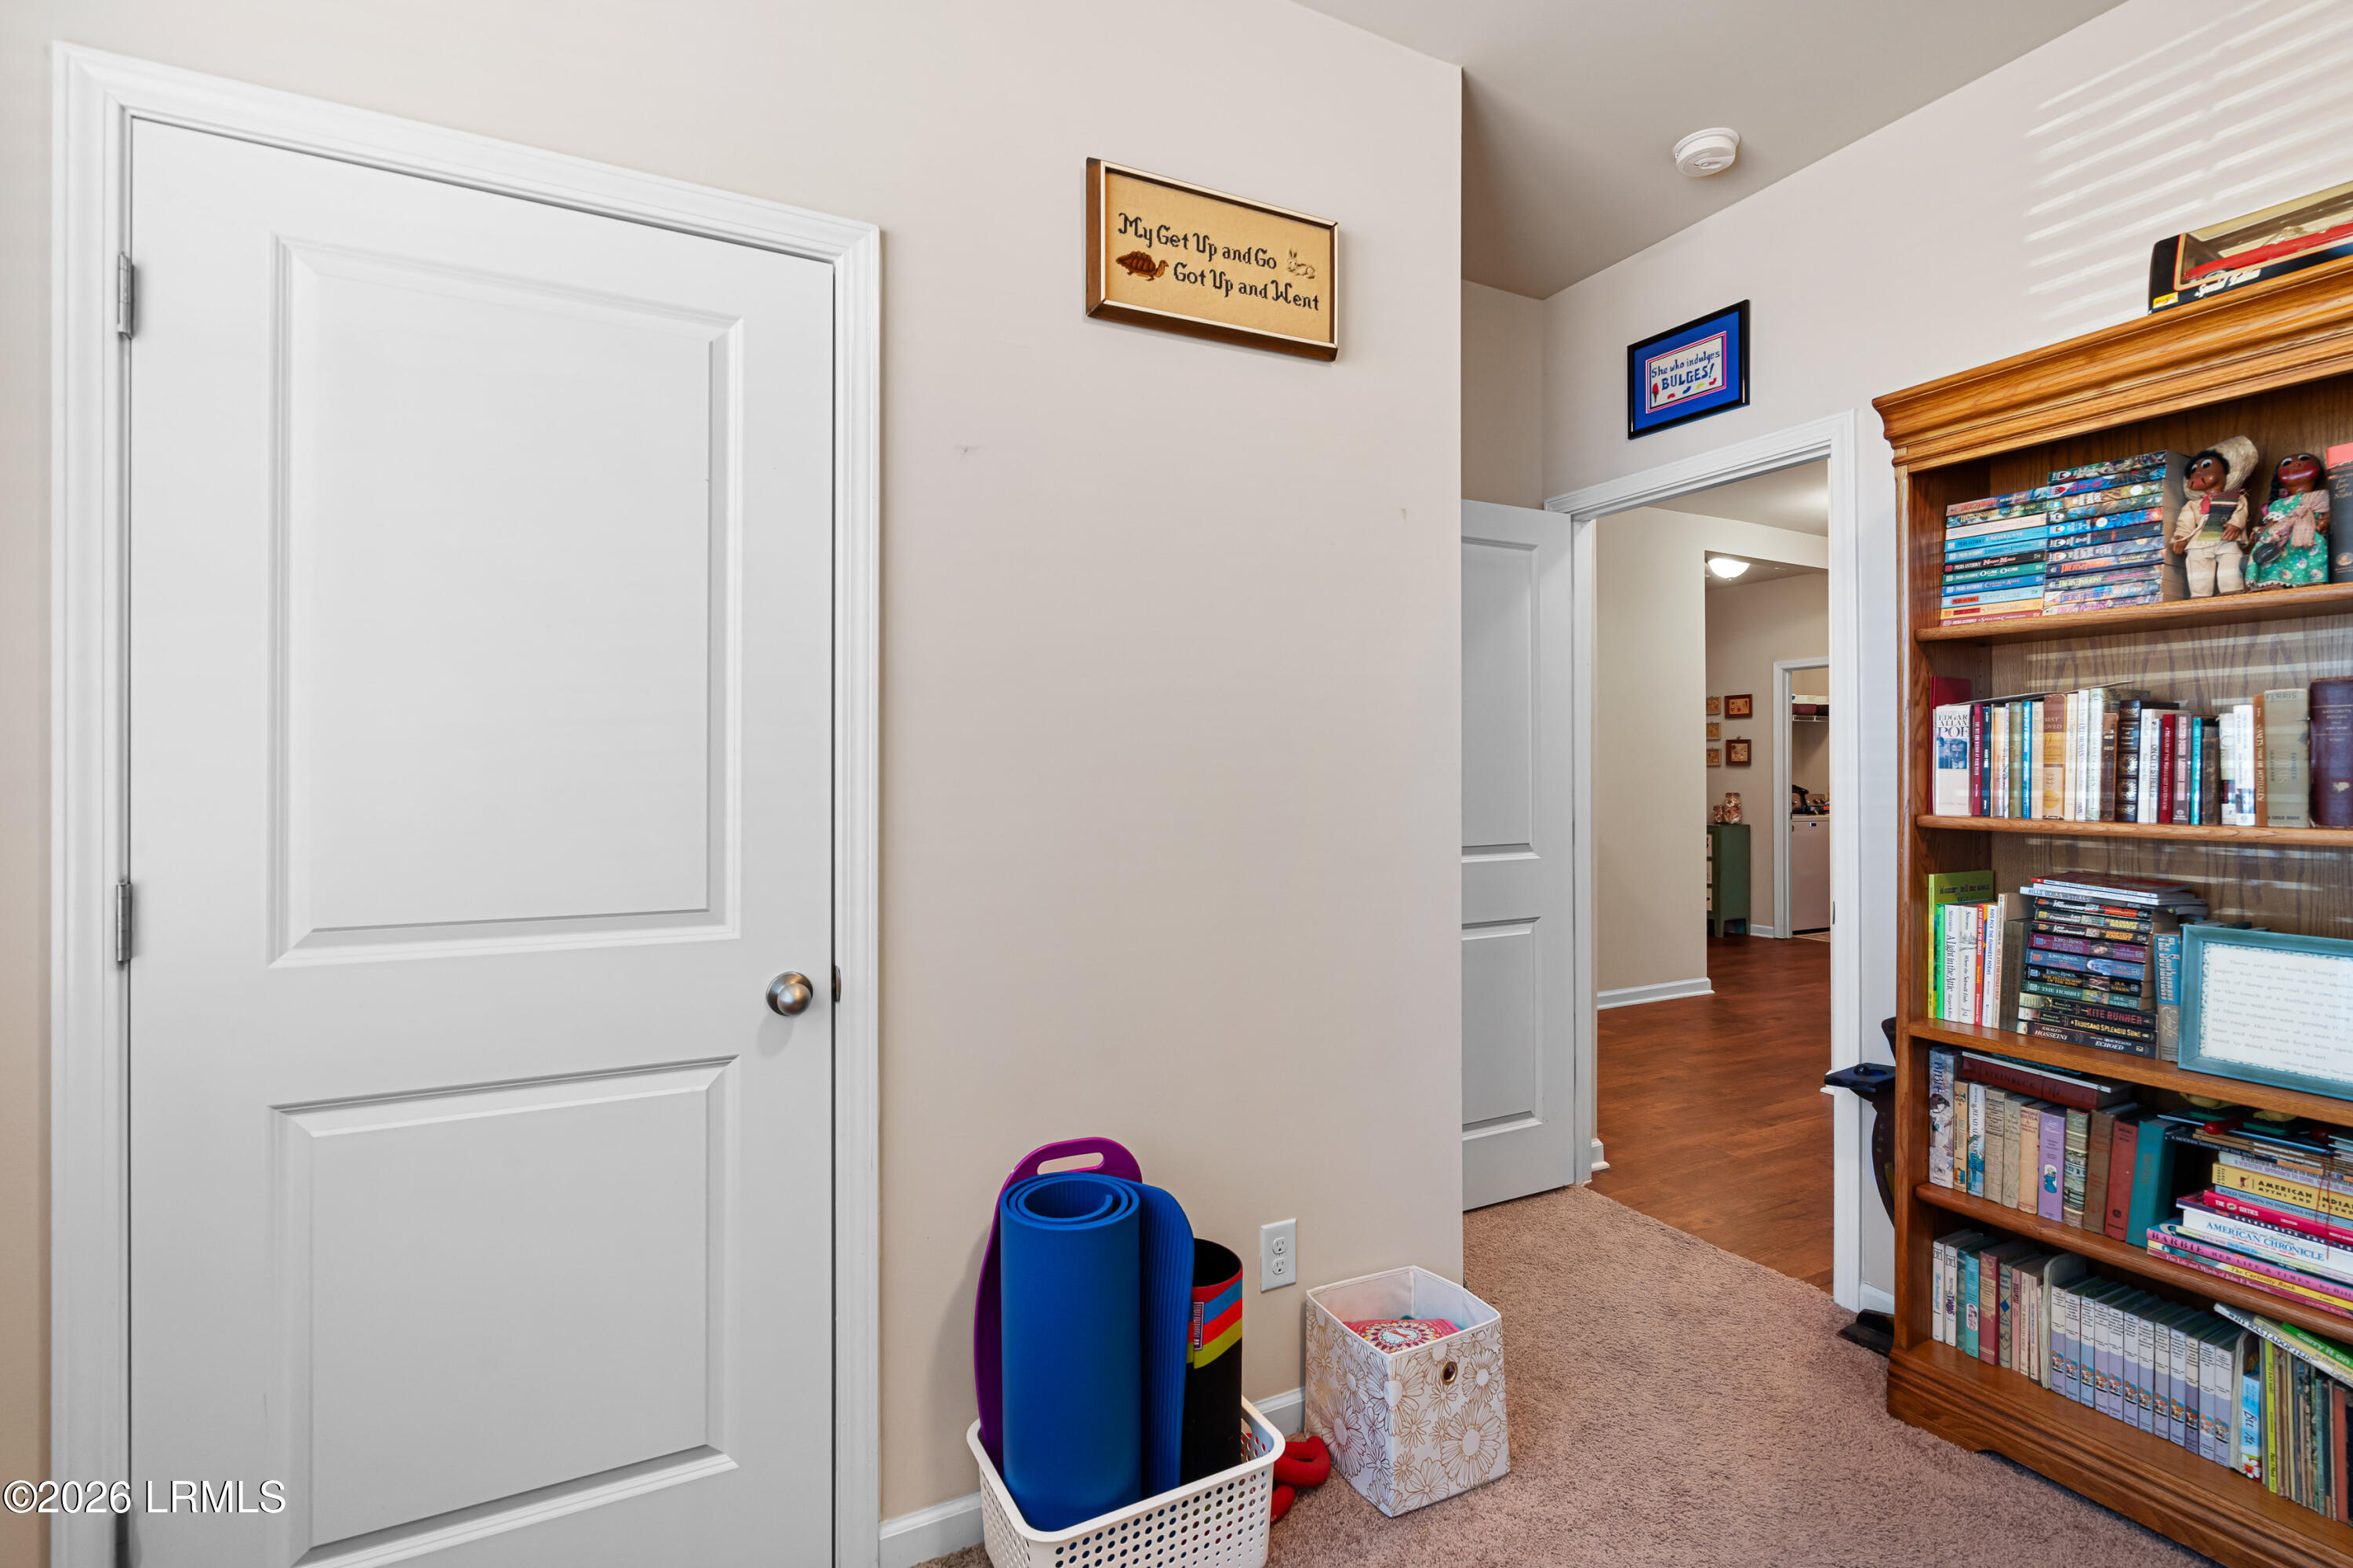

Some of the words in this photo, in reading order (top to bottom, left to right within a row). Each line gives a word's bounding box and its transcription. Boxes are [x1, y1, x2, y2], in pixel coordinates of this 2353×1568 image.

[1117, 212, 1153, 248] My
[1156, 224, 1189, 250] Get
[1192, 232, 1218, 261] Up
[1222, 246, 1252, 265] and
[1254, 247, 1278, 270] Go
[1173, 262, 1206, 286] Got
[1209, 270, 1234, 297] Up
[1238, 282, 1268, 300] and
[1271, 280, 1319, 311] Went
[1651, 366, 1668, 378] She
[1669, 358, 1685, 373] who
[1686, 351, 1720, 367] indulges
[1661, 362, 1715, 391] BULGES!
[2265, 691, 2297, 700] FERRIS
[1937, 726, 1969, 737] POE
[2151, 744, 2158, 754] ON
[1945, 941, 1956, 958] Light
[2158, 937, 2175, 951] The
[1947, 976, 1955, 991] Attic
[2086, 1007, 2105, 1018] KITE
[2107, 1011, 2142, 1024] RUNNER
[2035, 1030, 2068, 1040] HOSSEINI
[2075, 1020, 2100, 1031] THOUSAND
[2100, 1024, 2126, 1035] SPLENDID
[2095, 1041, 2125, 1050] ECHOED
[1933, 1061, 1944, 1093] BIBLE
[1985, 1070, 2035, 1089] STEINBECK
[2259, 1181, 2313, 1199] AMERICAN
[2259, 1187, 2287, 1198] MYTHS
[2292, 1195, 2311, 1204] AND
[2215, 1199, 2226, 1208] THE
[2238, 1206, 2259, 1217] SIXTIES
[2220, 1188, 2238, 1197] BOLD
[2238, 1193, 2265, 1204] WOMEN
[2275, 1202, 2304, 1215] INDIANA
[2305, 1210, 2334, 1222] HISTORY
[2235, 1215, 2299, 1237] CELEBRATES
[2306, 1235, 2326, 1244] THE
[2206, 1222, 2260, 1242] AMERICAN
[2264, 1238, 2325, 1261] CHRONICLE
[2151, 1232, 2204, 1254] BARBIE
[2212, 1252, 2231, 1262] HER
[2237, 1258, 2261, 1270] LIFE
[2231, 1267, 2243, 1275] The
[2245, 1270, 2275, 1286] Curiosity
[2278, 1281, 2296, 1290] Book
[2228, 1312, 2246, 1325] WHY
[2248, 1322, 2264, 1335] WAS
[2297, 1333, 2324, 1350] carry
[2326, 1347, 2335, 1356] it
[2336, 1354, 2351, 1366] on
